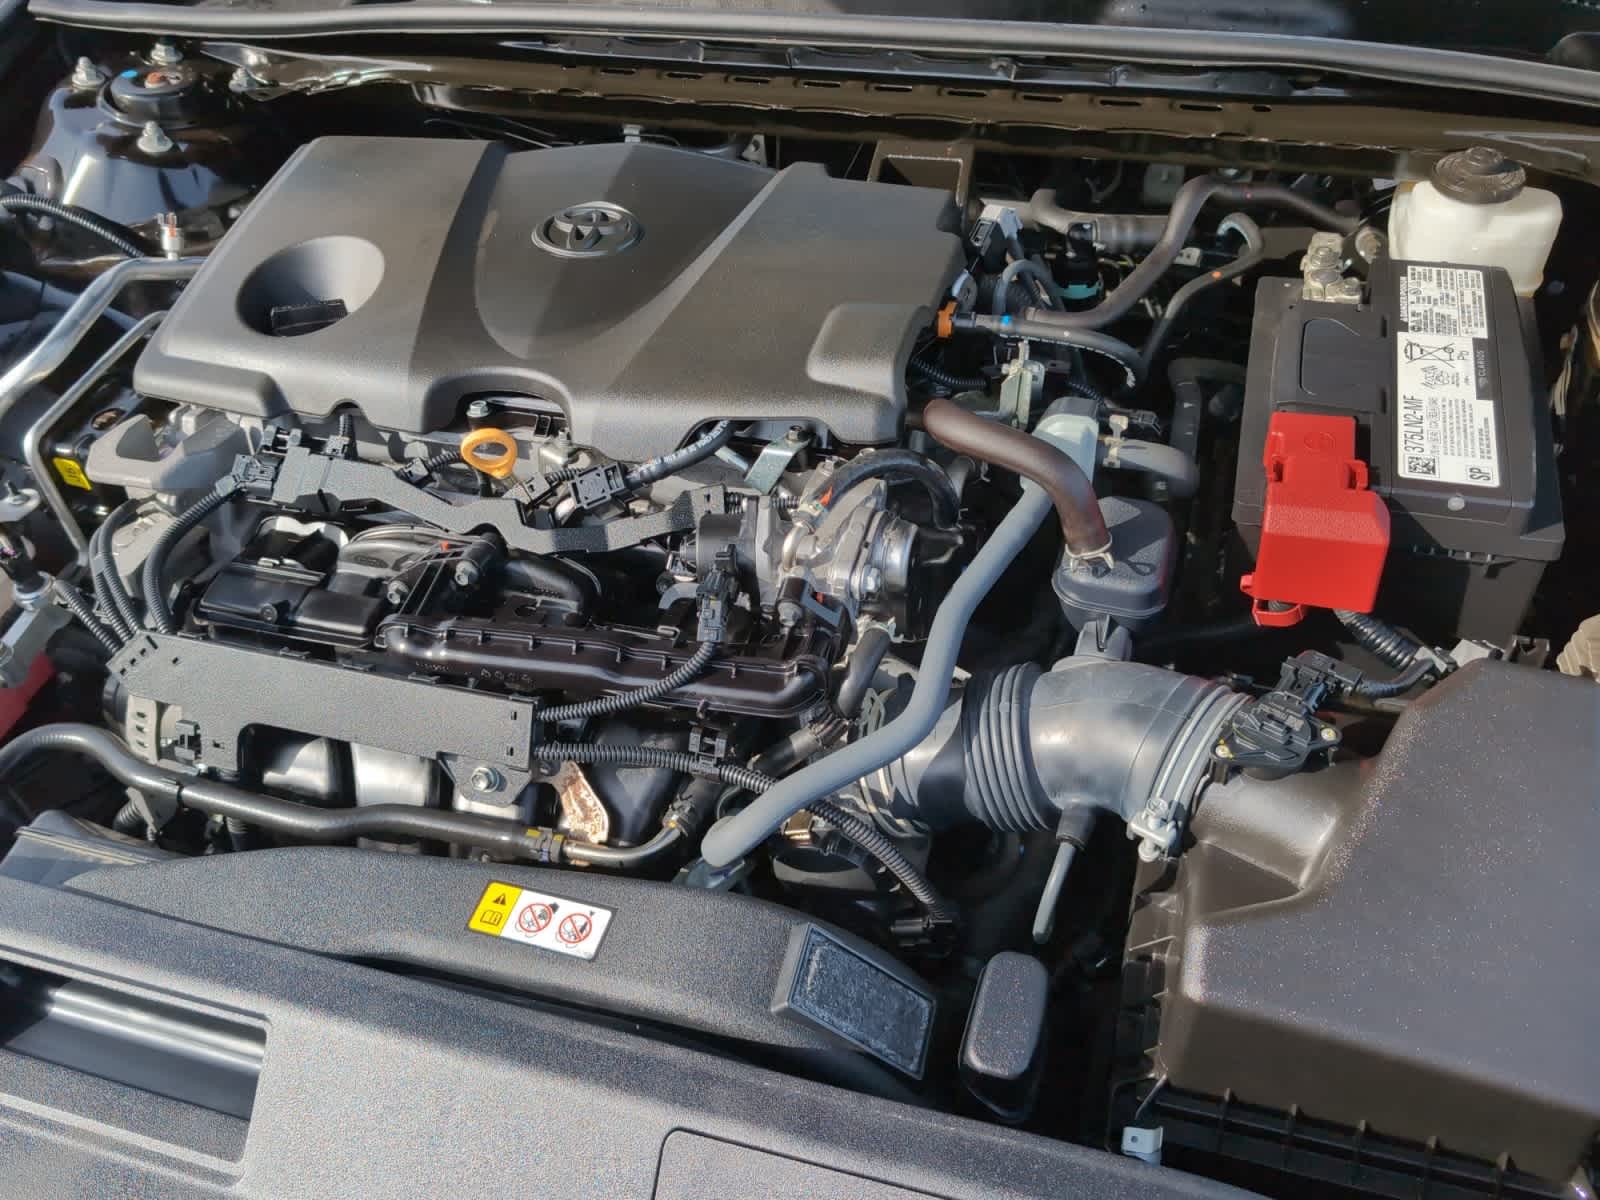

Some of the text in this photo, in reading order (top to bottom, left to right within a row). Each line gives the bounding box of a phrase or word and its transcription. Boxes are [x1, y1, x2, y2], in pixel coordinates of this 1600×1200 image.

[1457, 350, 1469, 361] Pb
[1403, 395, 1424, 453] 375LN2-MF
[1470, 466, 1491, 482] SP
